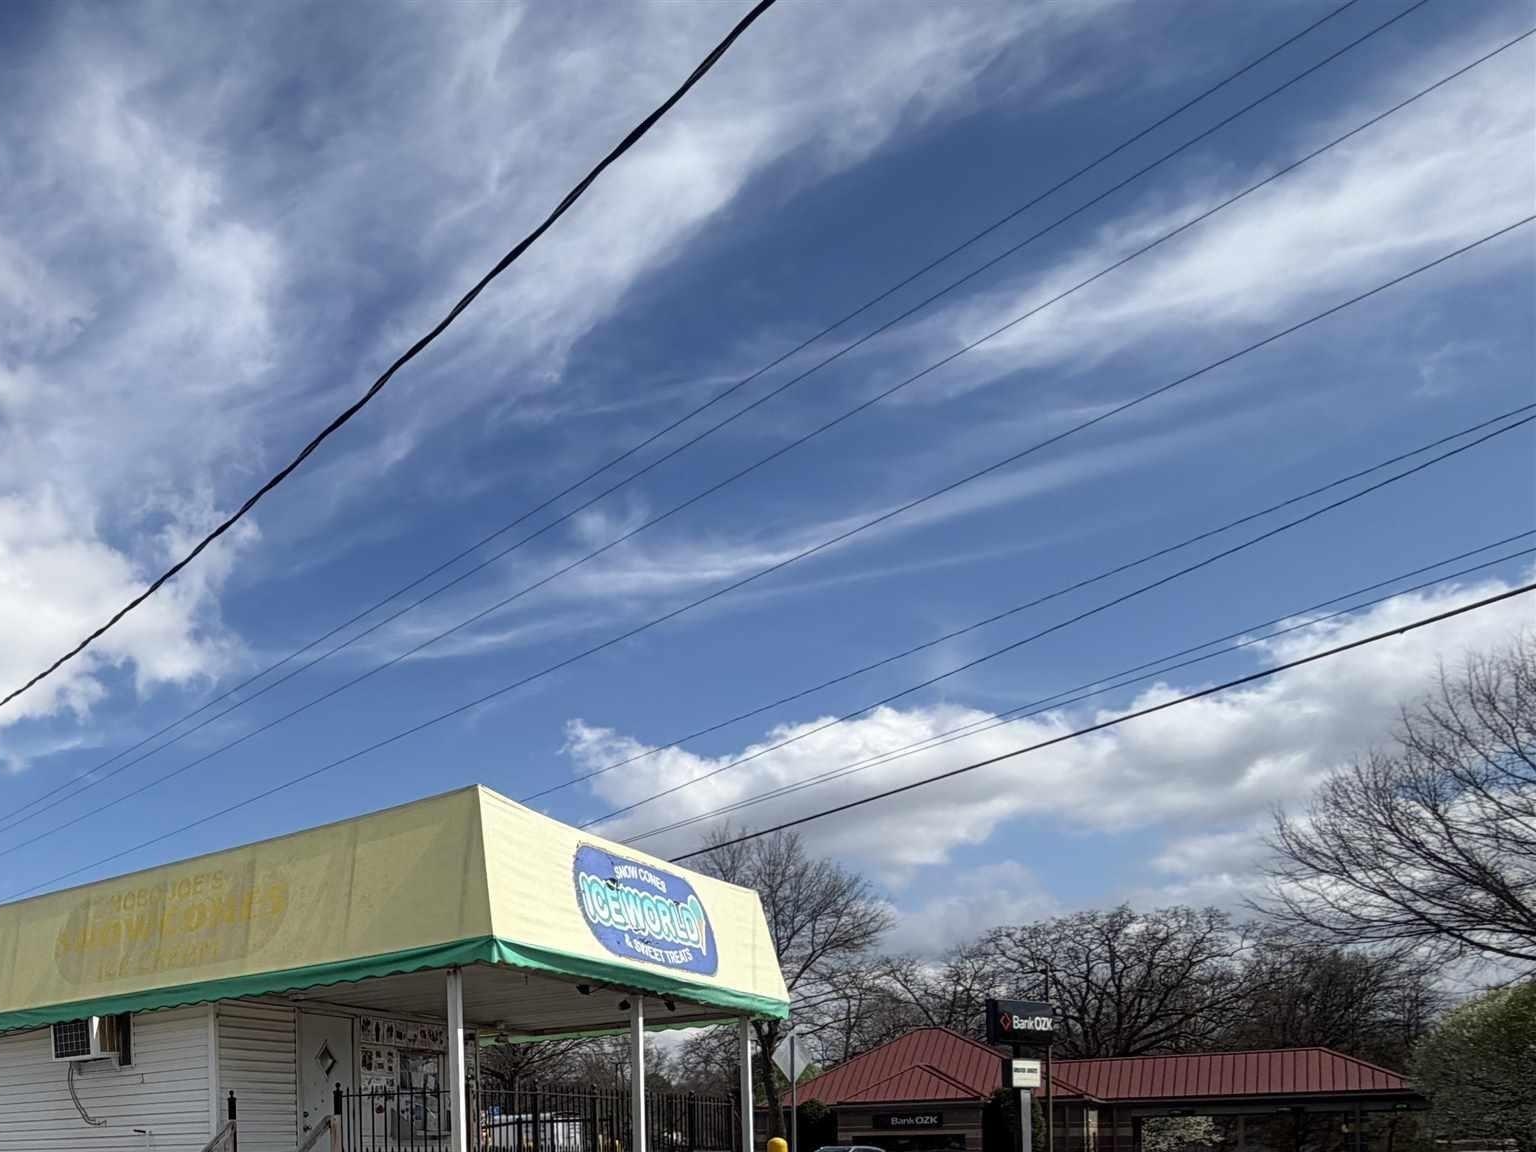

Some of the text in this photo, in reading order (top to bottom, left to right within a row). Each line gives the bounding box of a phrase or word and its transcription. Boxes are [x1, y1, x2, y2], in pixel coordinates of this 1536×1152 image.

[614, 865, 667, 893] SNOW CONES
[579, 872, 702, 949] ICEWORLD
[633, 939, 665, 963] SWEET
[664, 947, 694, 964] TREATS
